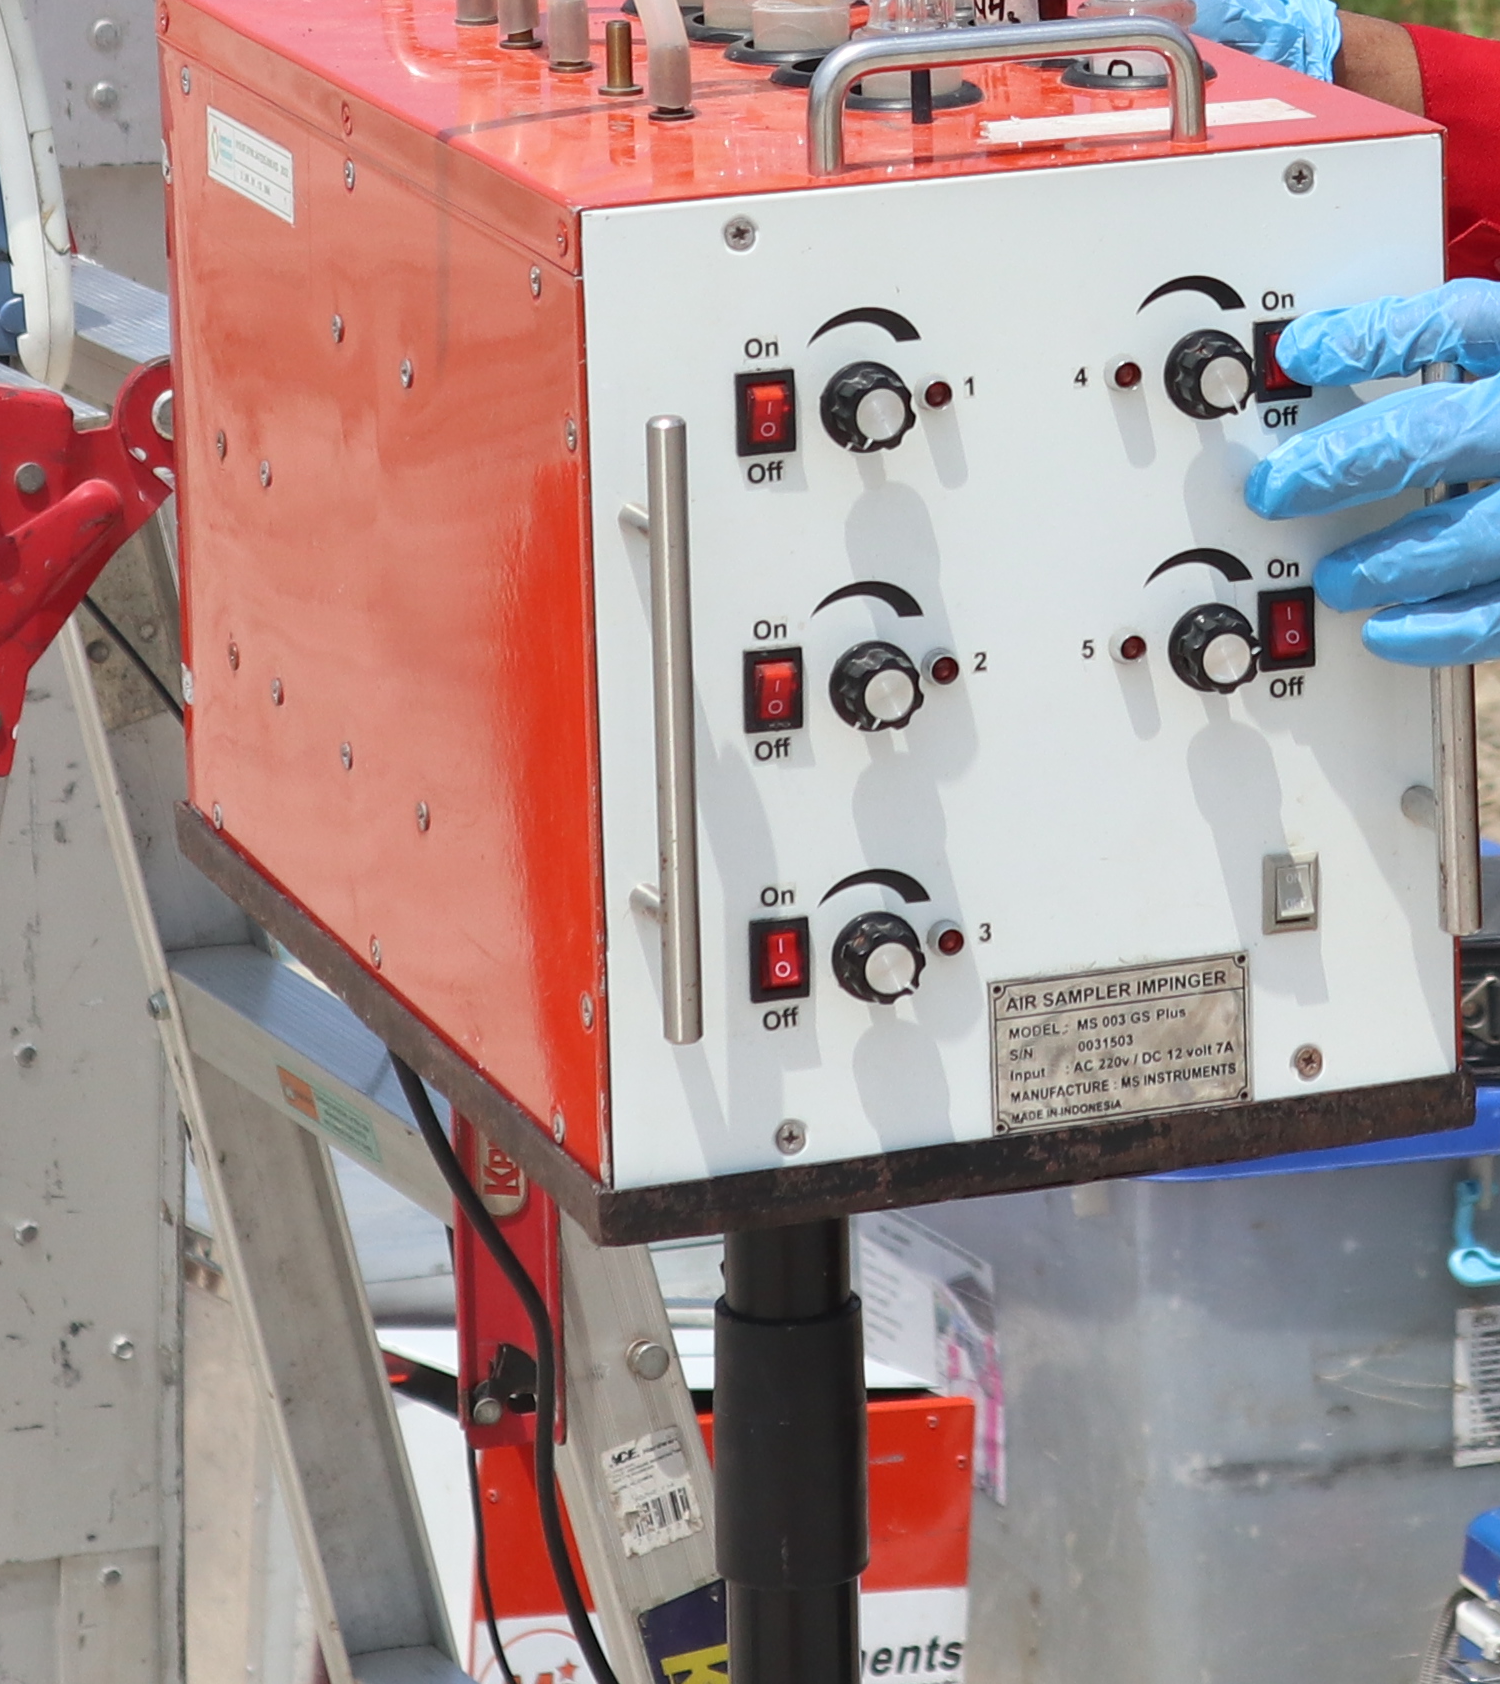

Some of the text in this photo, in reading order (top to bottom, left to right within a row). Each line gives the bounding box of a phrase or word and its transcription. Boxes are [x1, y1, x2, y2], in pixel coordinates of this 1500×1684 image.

[1262, 291, 1294, 311] On
[745, 338, 778, 359] On
[964, 377, 974, 396] 1
[1075, 368, 1088, 387] 4
[1263, 405, 1298, 428] Off
[747, 460, 783, 483] Off
[1268, 559, 1299, 579] On
[754, 620, 786, 641] On
[1082, 640, 1095, 659] 5
[974, 652, 987, 672] 2
[1270, 676, 1305, 699] Off
[754, 738, 790, 761] Off
[761, 887, 794, 908] On
[979, 923, 992, 943] 3
[1005, 970, 1226, 1013] AIR SAMPLER IMPINGER
[763, 1006, 798, 1030] Off
[1077, 1018, 1098, 1032] MS
[1102, 1014, 1126, 1028] 003
[1131, 1010, 1151, 1024] GS
[1156, 1008, 1187, 1021] Plus
[1010, 1034, 1134, 1062] S/N 0031503
[1010, 1068, 1045, 1083] Input
[1074, 1059, 1094, 1074] AC
[1099, 1056, 1129, 1071] 220v
[1142, 1051, 1162, 1064] DC
[1167, 1047, 1183, 1061] 12
[1186, 1044, 1212, 1058] volt
[1216, 1040, 1234, 1054] 7A
[1010, 1079, 1110, 1104] MANUFACTURE
[1121, 1076, 1140, 1089] MS
[1143, 1062, 1237, 1086] INSTRUMENTS
[1011, 1108, 1044, 1124] MADE
